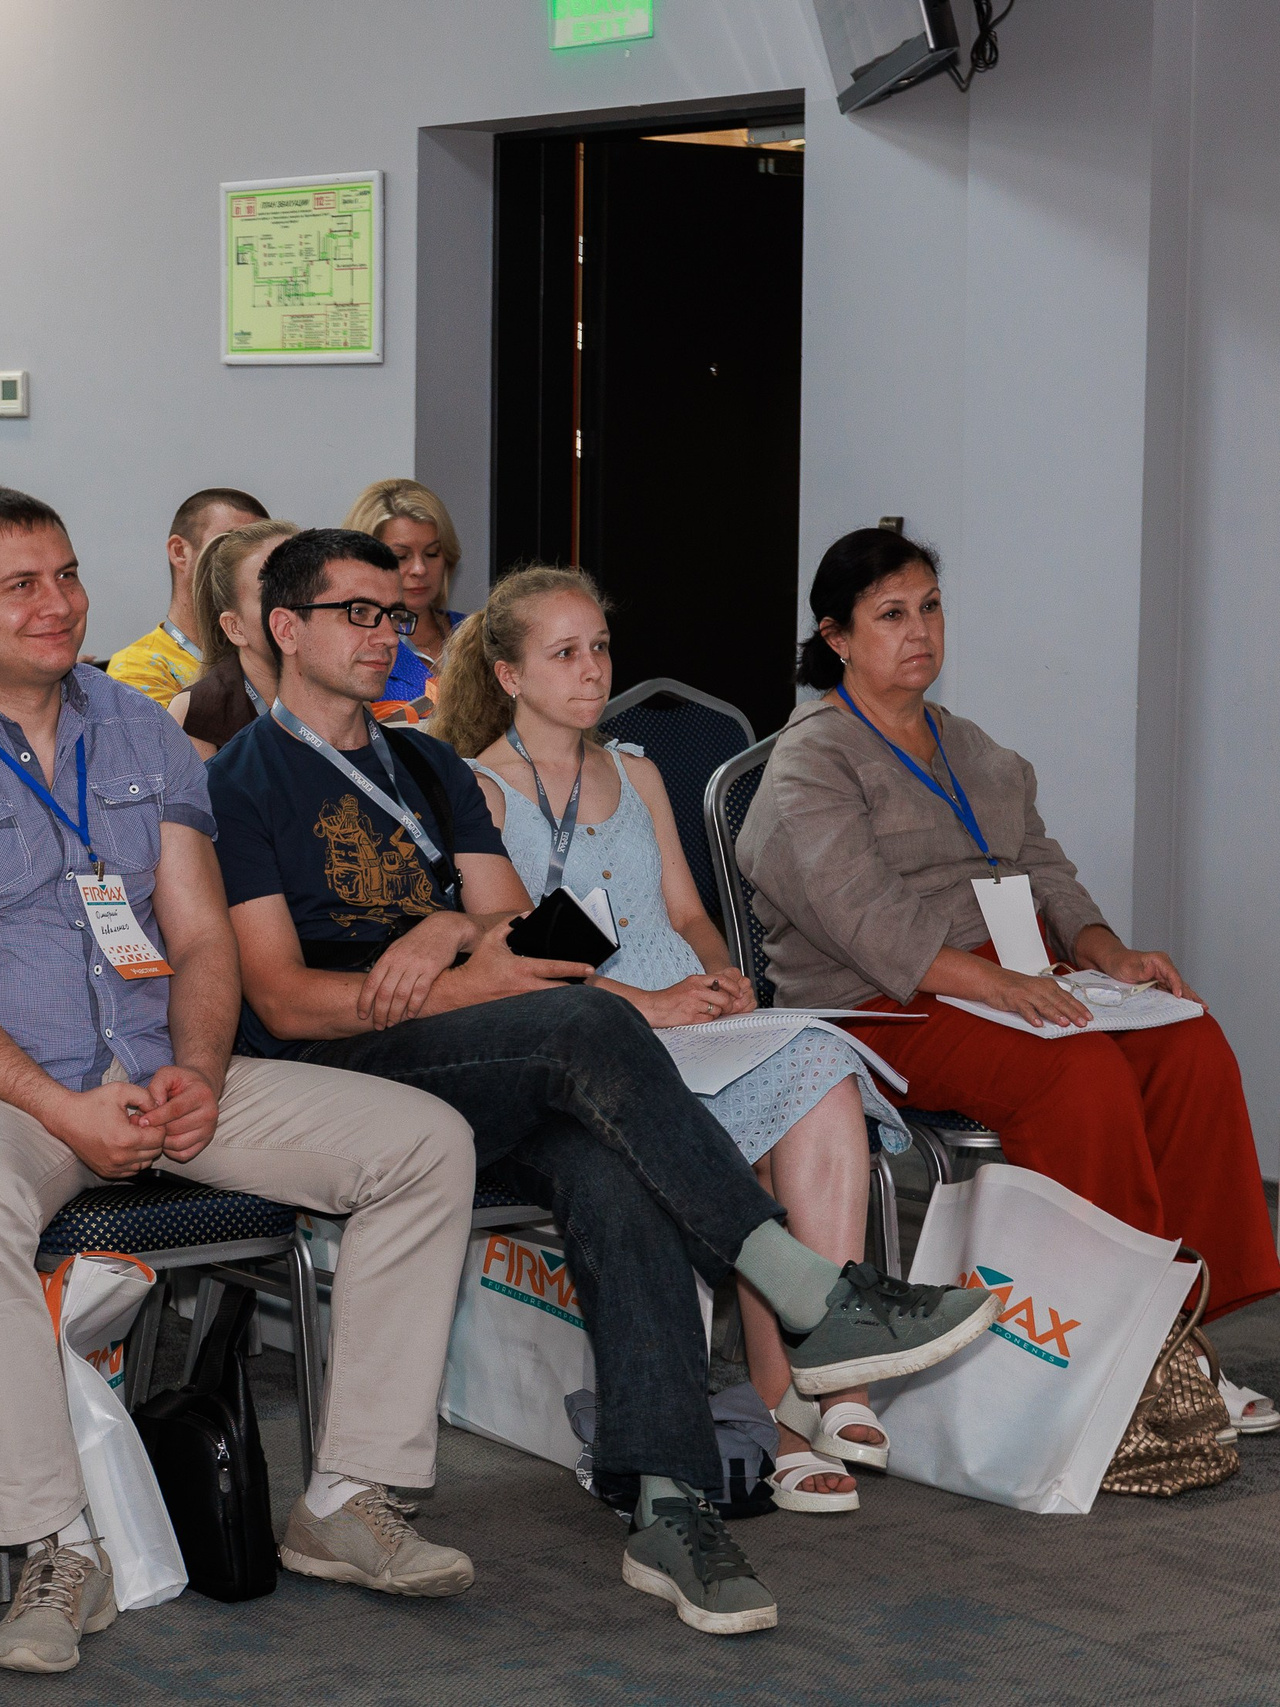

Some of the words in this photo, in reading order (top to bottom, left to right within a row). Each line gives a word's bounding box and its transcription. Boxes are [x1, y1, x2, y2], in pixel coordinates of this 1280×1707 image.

[573, 18, 628, 40] EXIT
[299, 726, 323, 748] FIRMAX
[350, 770, 374, 792] FIRMAX
[401, 815, 422, 839] FIRMAX
[82, 886, 125, 901] FIRMAX
[130, 967, 160, 975] Участник
[488, 1281, 542, 1307] FURNITURE
[545, 1304, 586, 1328] COMPONE
